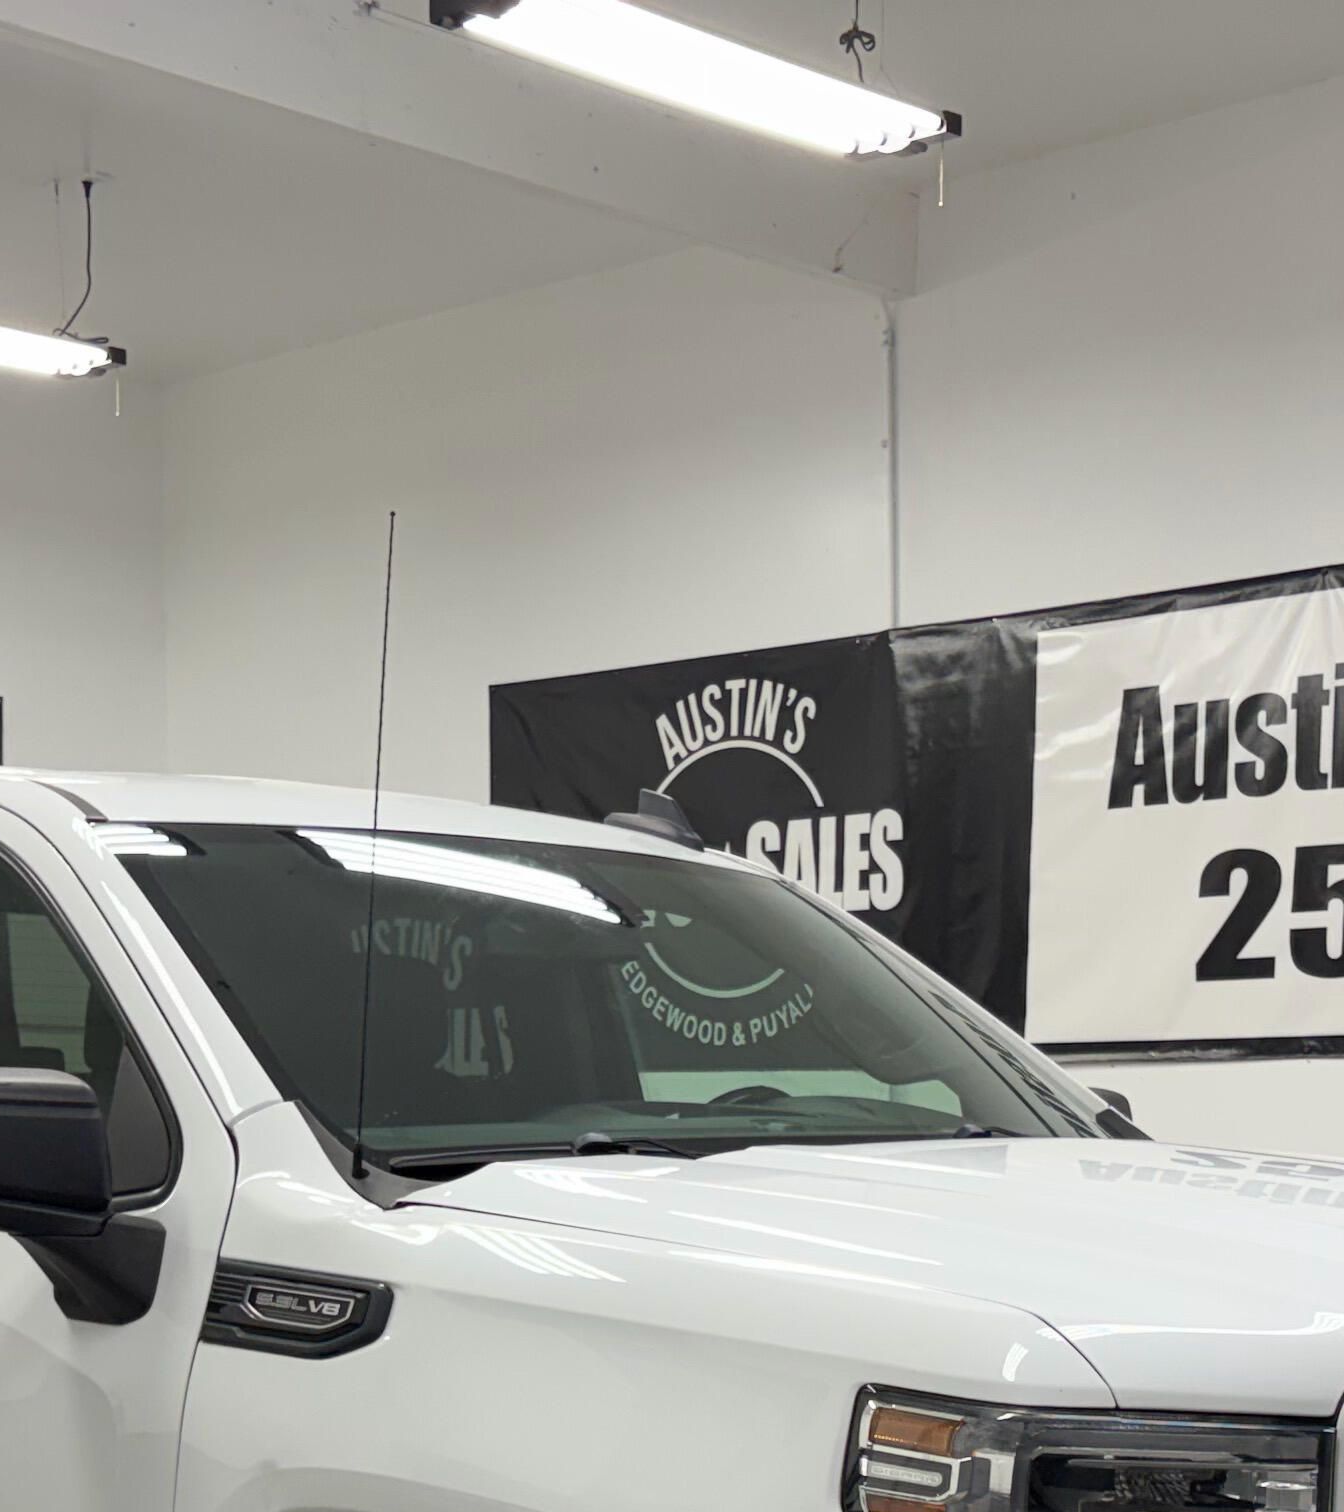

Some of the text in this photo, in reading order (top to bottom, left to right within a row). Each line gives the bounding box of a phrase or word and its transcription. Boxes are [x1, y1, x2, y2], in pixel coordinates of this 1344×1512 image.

[655, 678, 817, 771] AUSTIN'S
[621, 960, 727, 1046] EDGEWOOD
[732, 1022, 746, 1046] &
